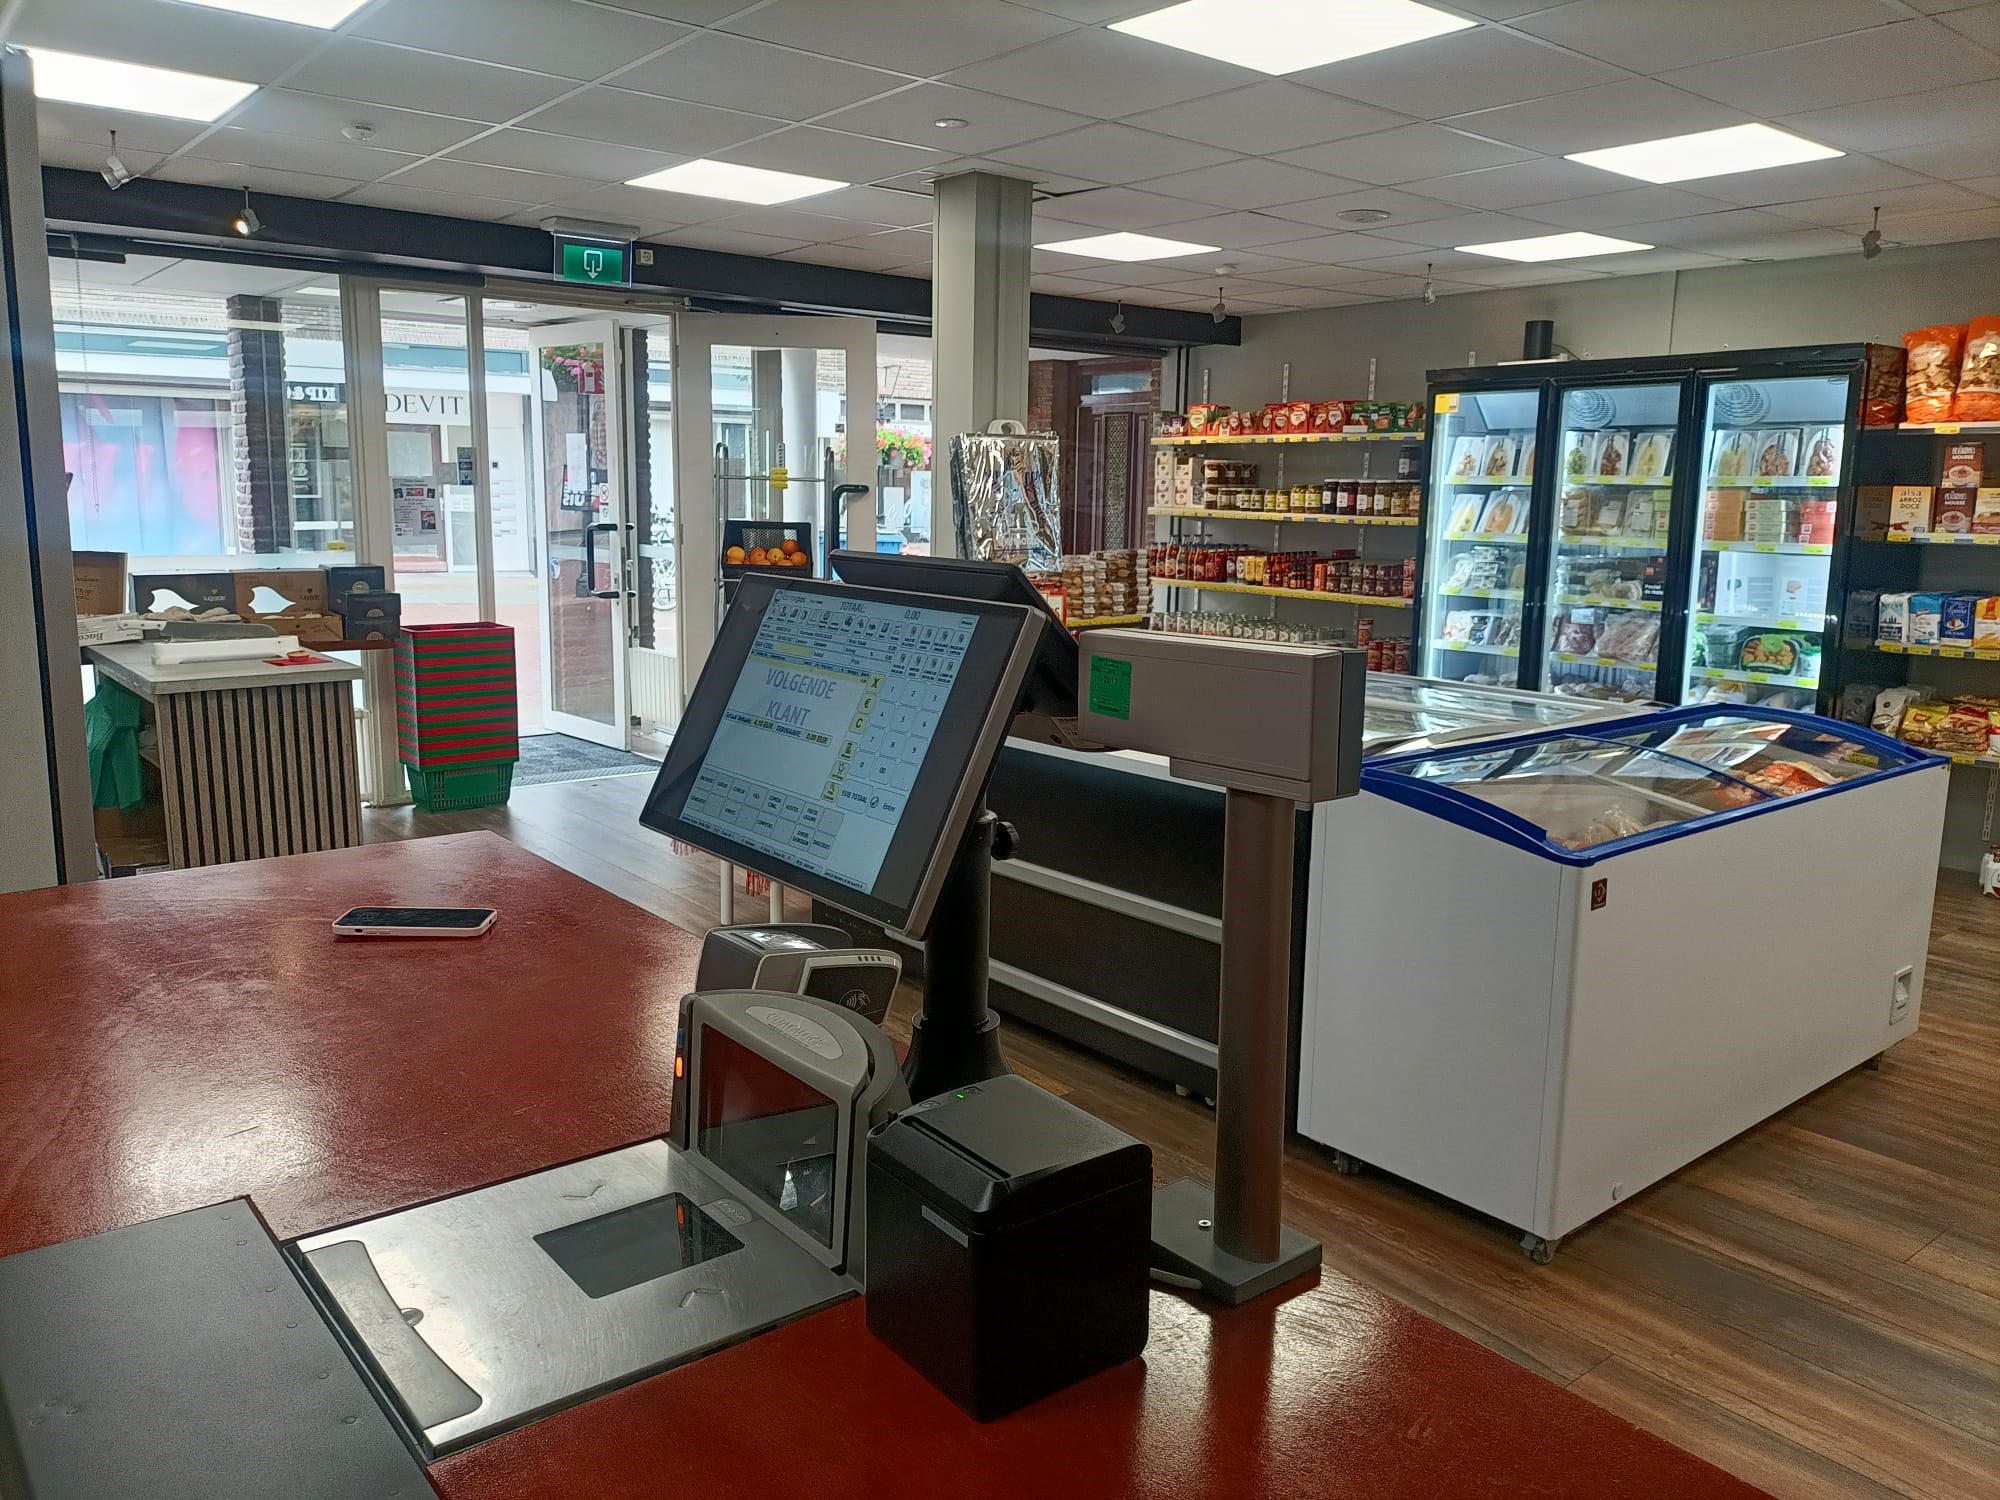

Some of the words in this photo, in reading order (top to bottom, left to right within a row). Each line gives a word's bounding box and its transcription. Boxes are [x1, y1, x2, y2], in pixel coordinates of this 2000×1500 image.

[385, 394, 464, 415] DEVIT
[904, 609, 921, 621] 0,00
[766, 668, 837, 699] VOLGENDE
[870, 678, 879, 689] X
[864, 698, 871, 708] €
[765, 700, 811, 726] KLANT
[856, 718, 863, 729] C
